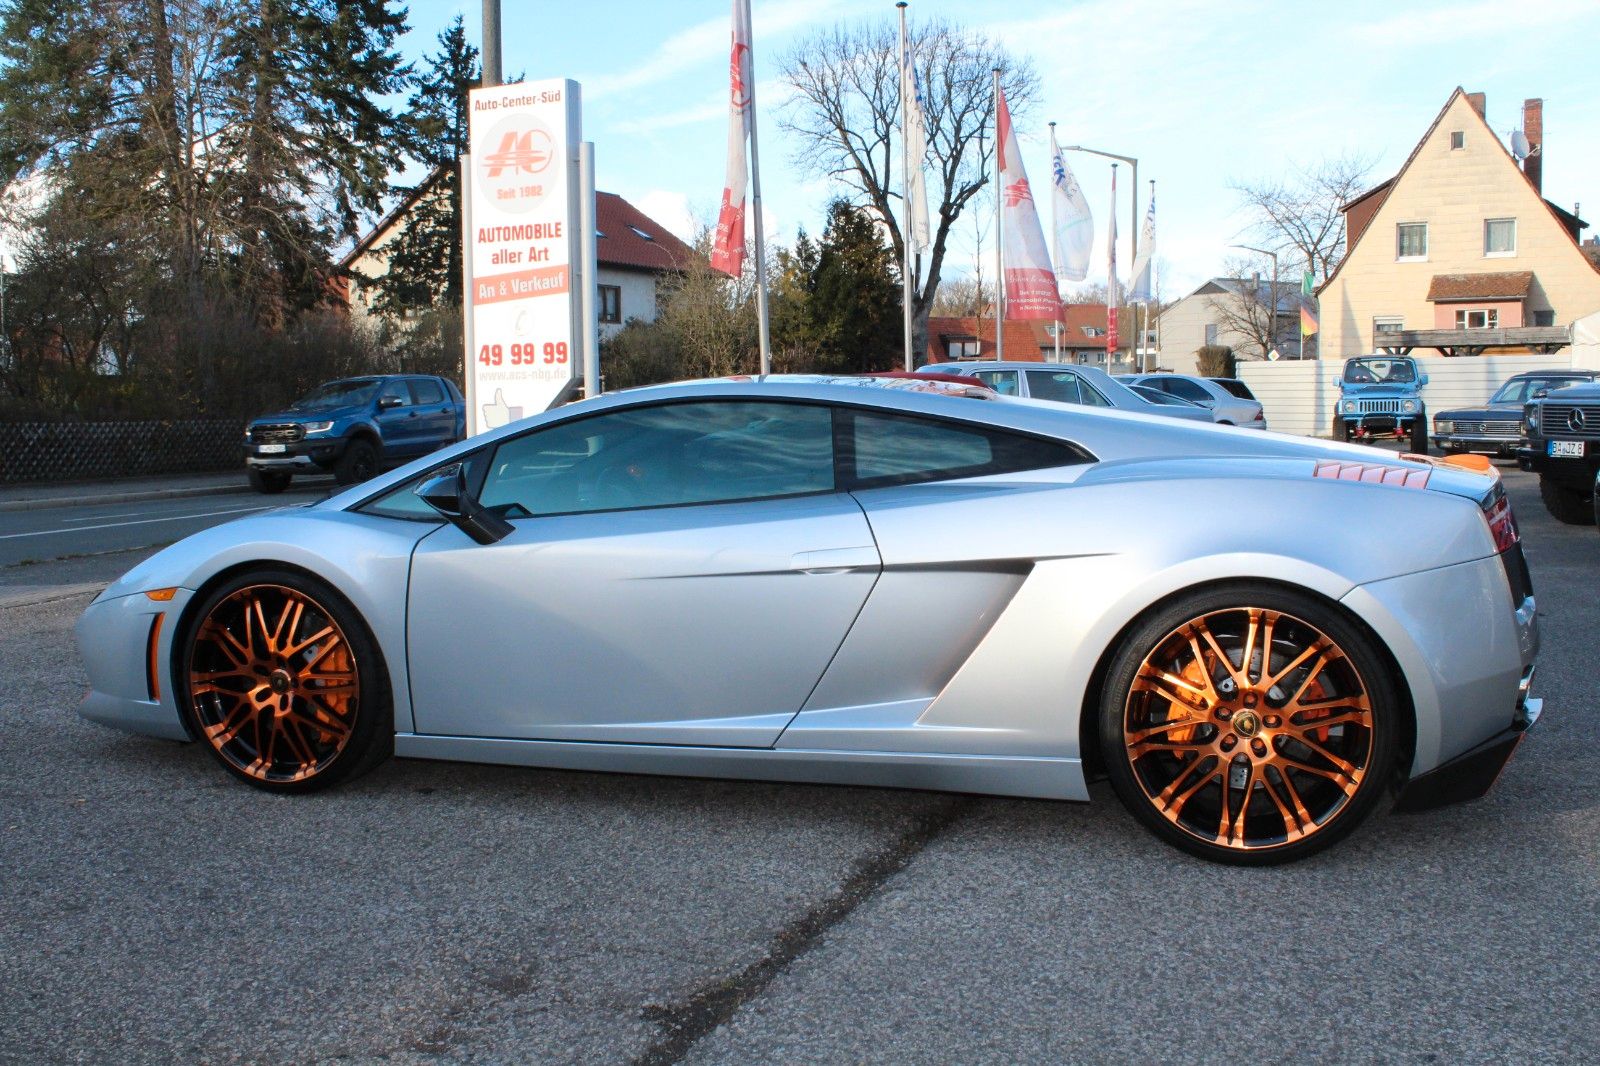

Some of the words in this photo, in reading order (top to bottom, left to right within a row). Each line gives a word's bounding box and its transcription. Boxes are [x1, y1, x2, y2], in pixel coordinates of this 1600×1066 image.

[475, 90, 561, 111] Auto-Center-Süd
[497, 188, 515, 200] Seit
[520, 185, 543, 198] 1982
[478, 222, 562, 243] AUTOMOBILE
[492, 249, 523, 264] aller
[528, 246, 549, 262] Art
[480, 284, 495, 299] An
[499, 281, 507, 296] &
[511, 271, 564, 294] Verkauf
[479, 344, 502, 366] 49
[511, 343, 534, 365] 99
[543, 341, 567, 364] 99
